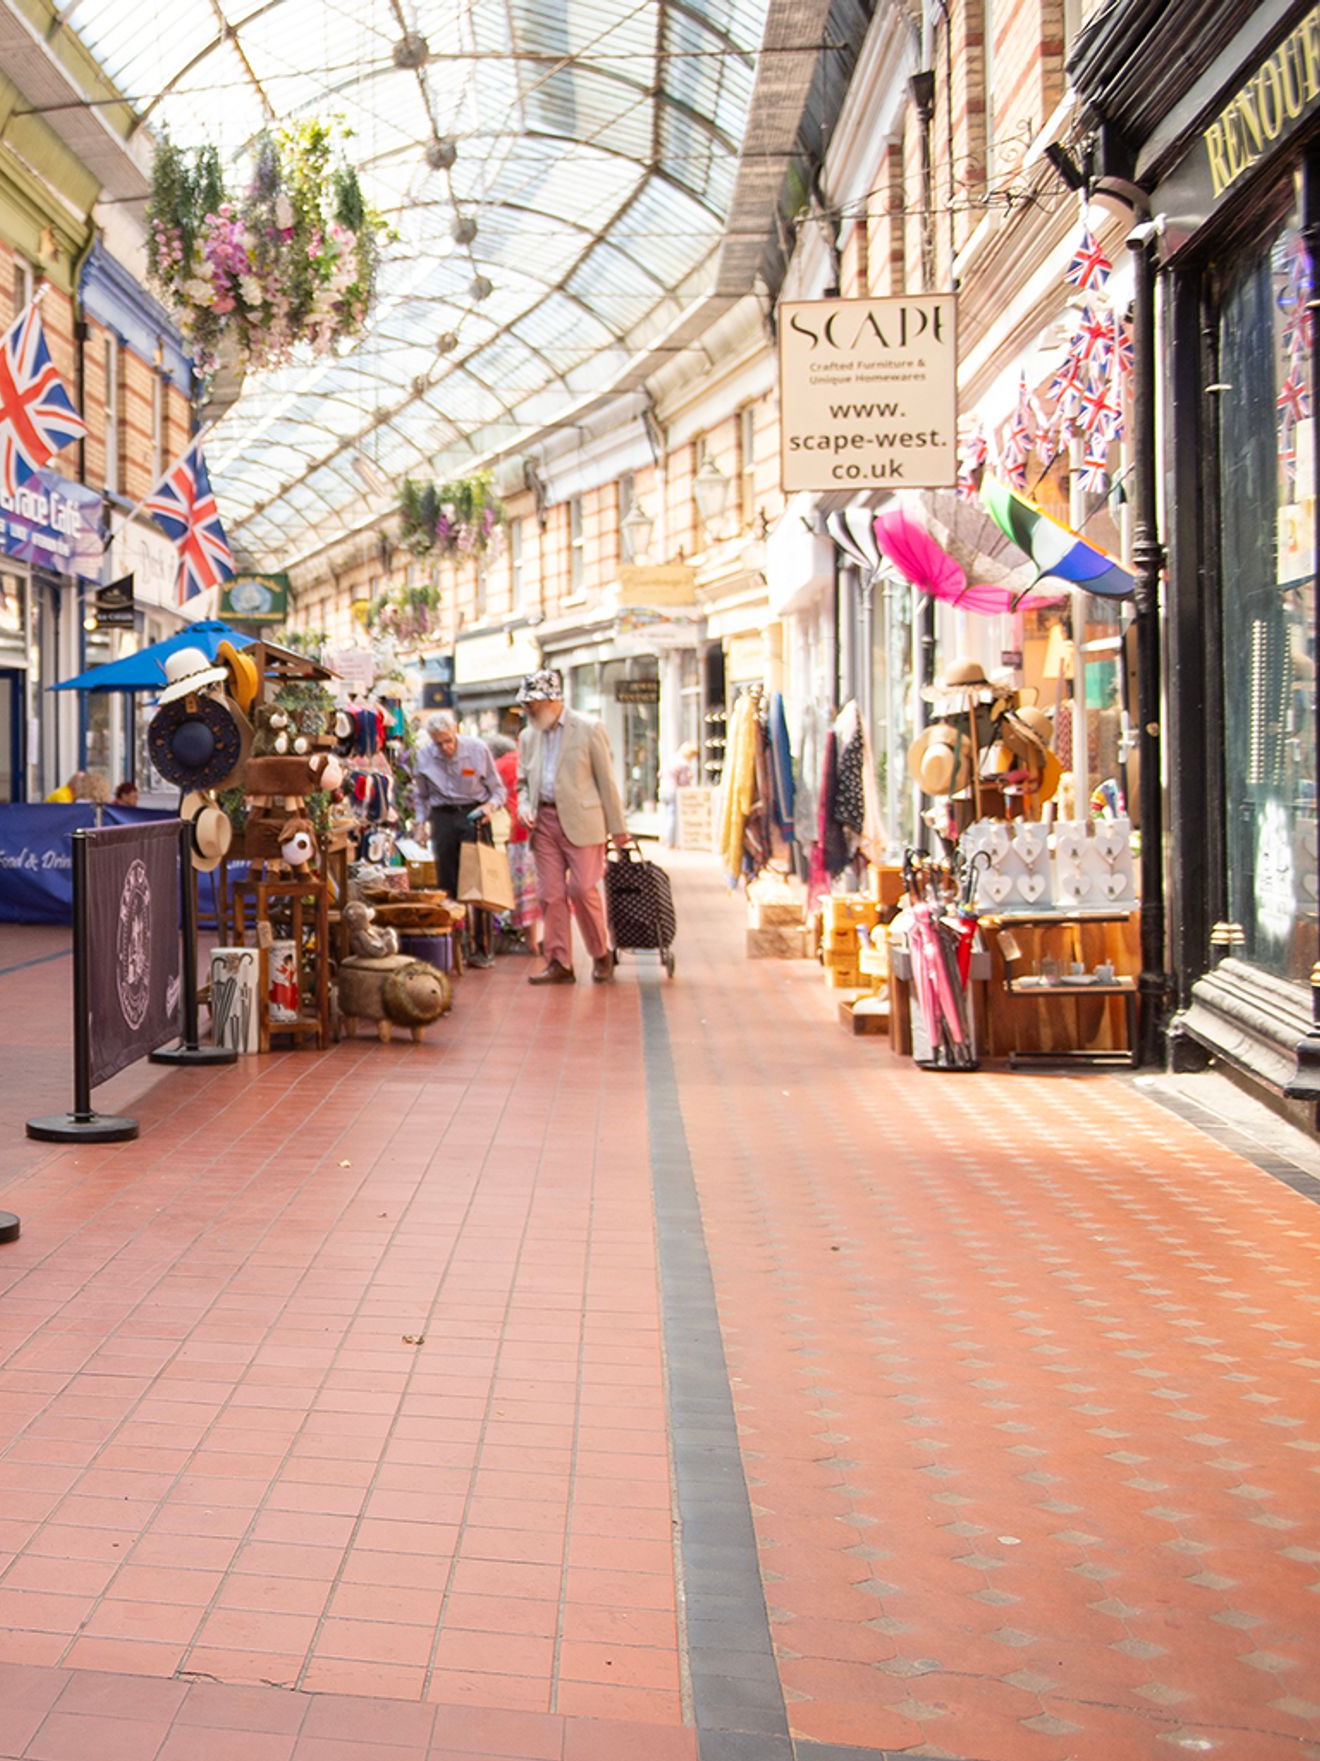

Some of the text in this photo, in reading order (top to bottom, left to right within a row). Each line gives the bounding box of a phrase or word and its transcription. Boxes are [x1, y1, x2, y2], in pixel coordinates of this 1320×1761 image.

[790, 306, 945, 351] SCAPE
[810, 358, 926, 372] Crafted Furniture &
[809, 373, 926, 387] Unique Homewares
[829, 402, 906, 418] www.
[789, 430, 948, 454] scape-west.
[832, 459, 904, 480] co.uk
[41, 850, 72, 869] Drin
